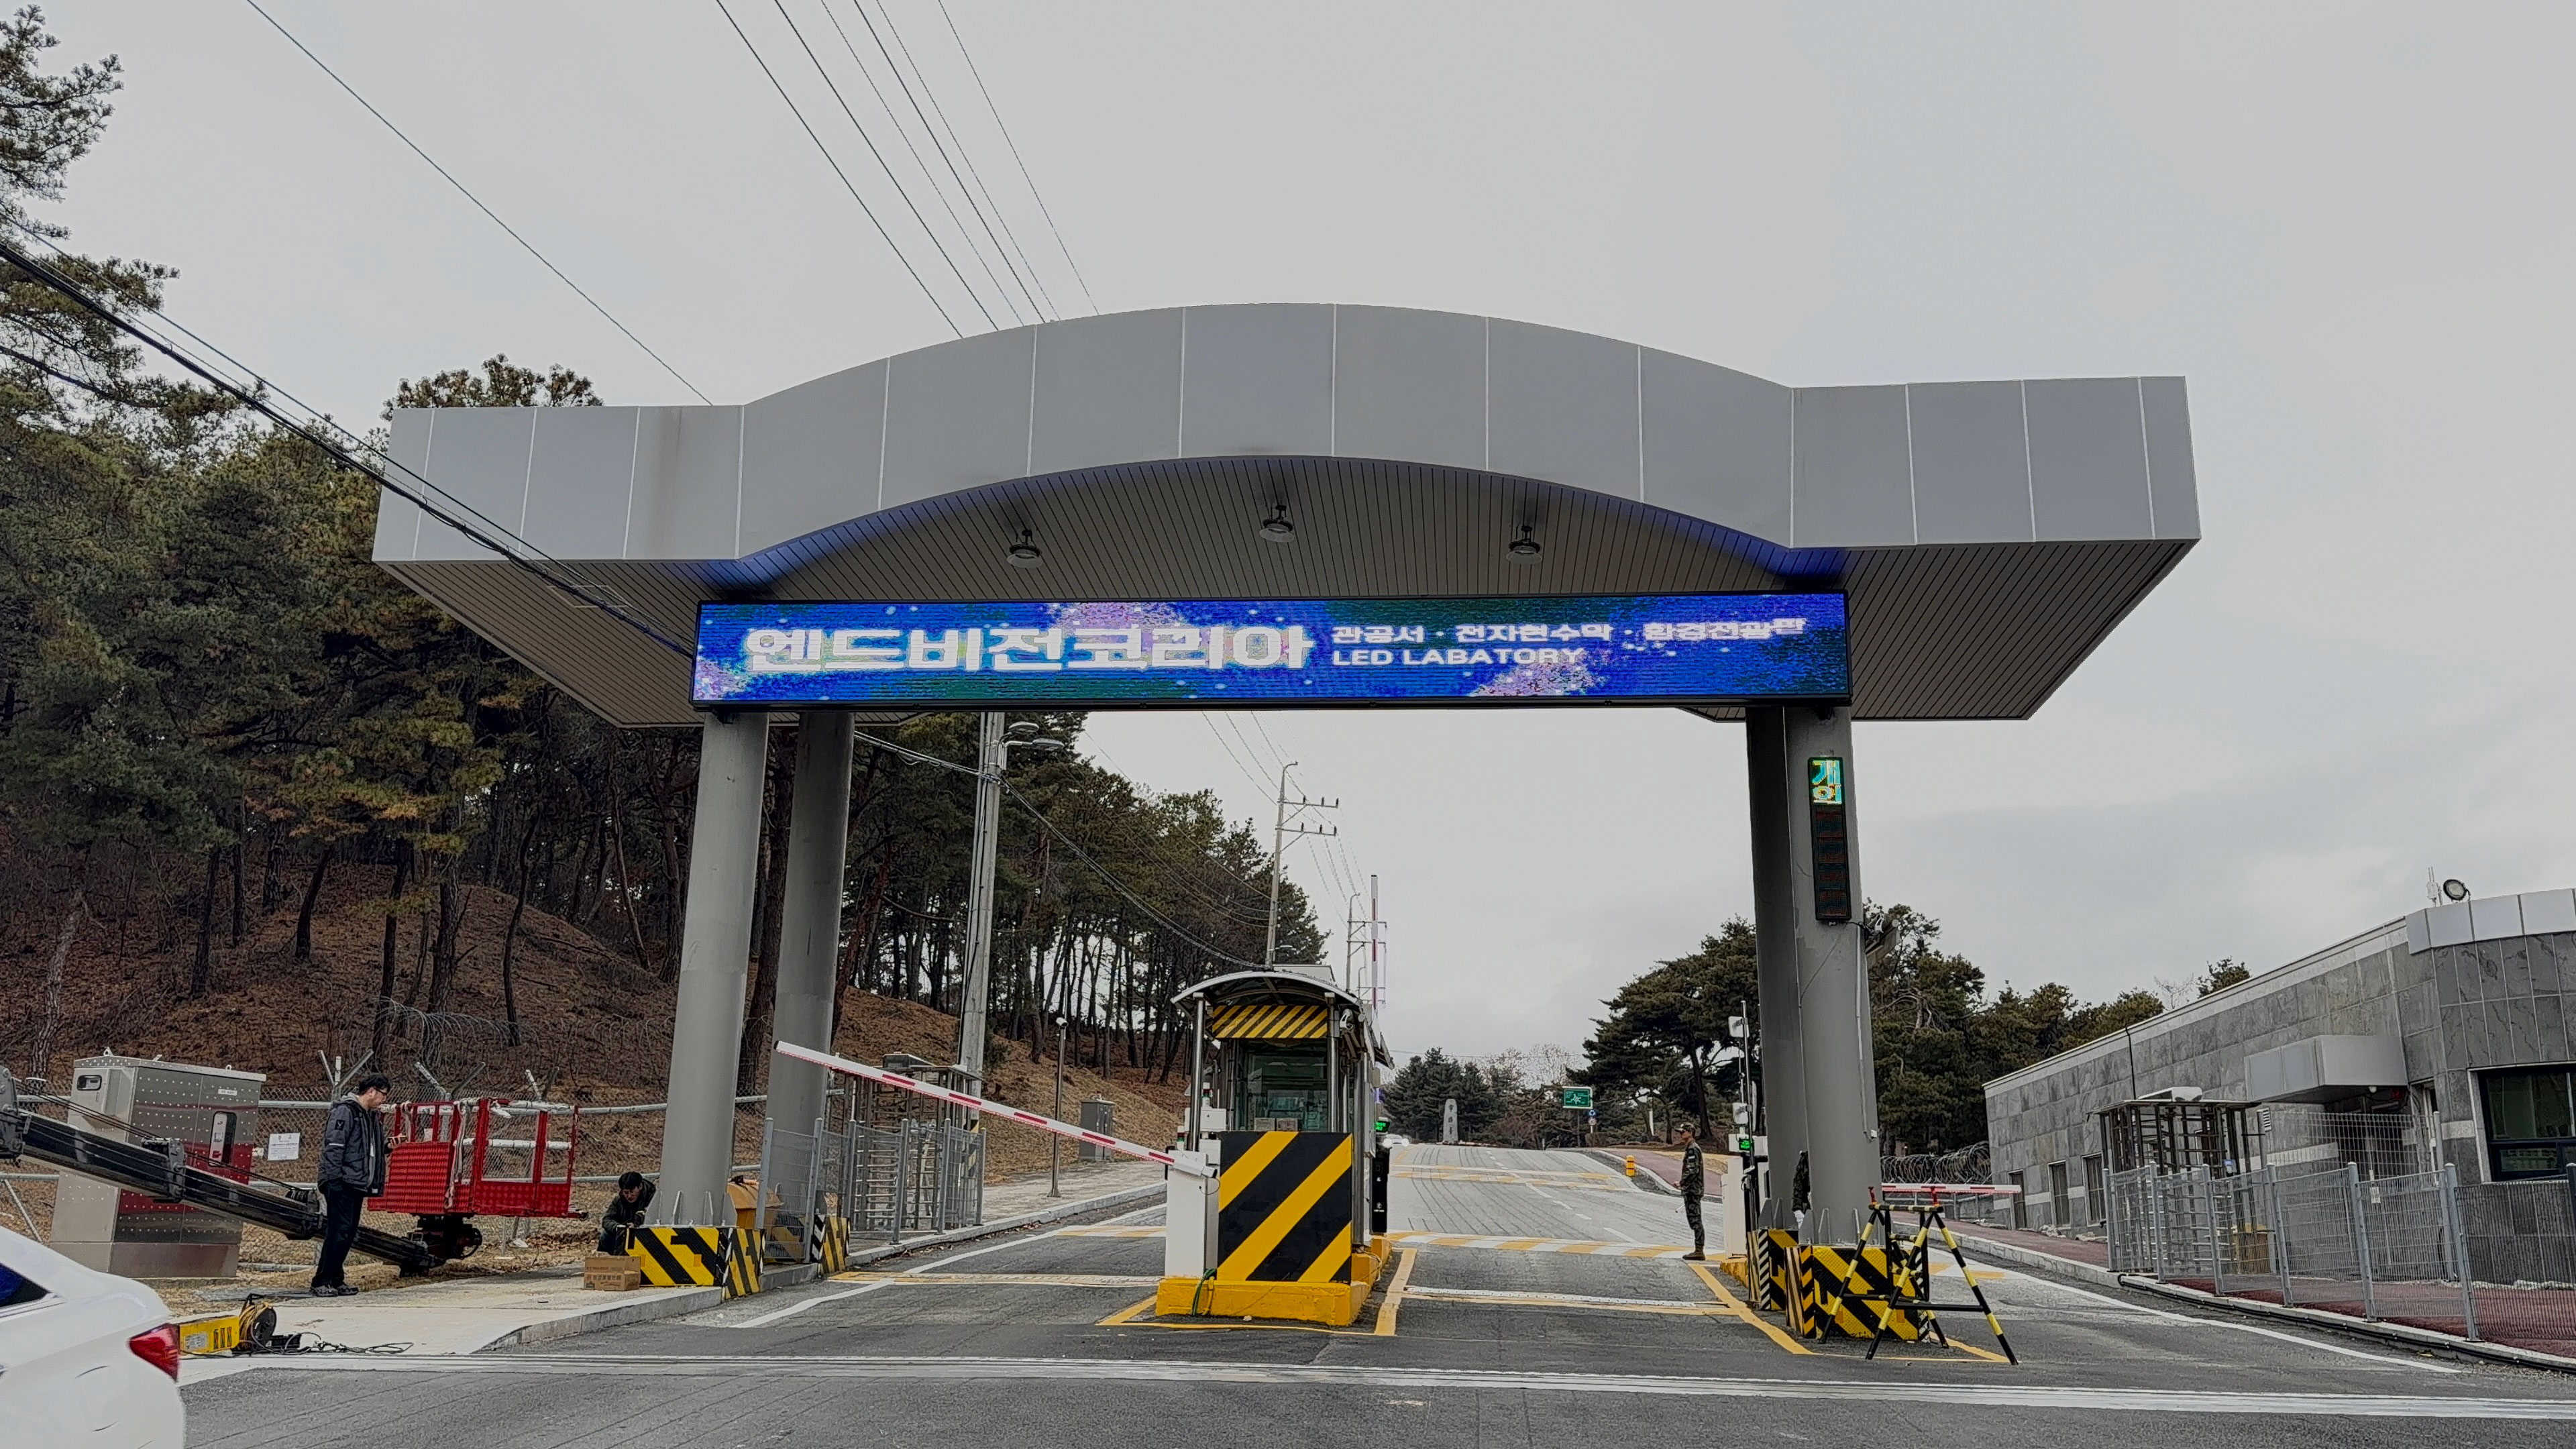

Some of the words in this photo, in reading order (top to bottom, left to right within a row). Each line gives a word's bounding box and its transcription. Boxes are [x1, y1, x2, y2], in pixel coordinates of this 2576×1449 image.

[1332, 626, 1425, 644] 관공서
[1455, 625, 1614, 643] 전자현수막
[747, 627, 1316, 671] 엔드비전코리아
[1332, 649, 1393, 666] LED
[1403, 648, 1585, 665] LABATORY
